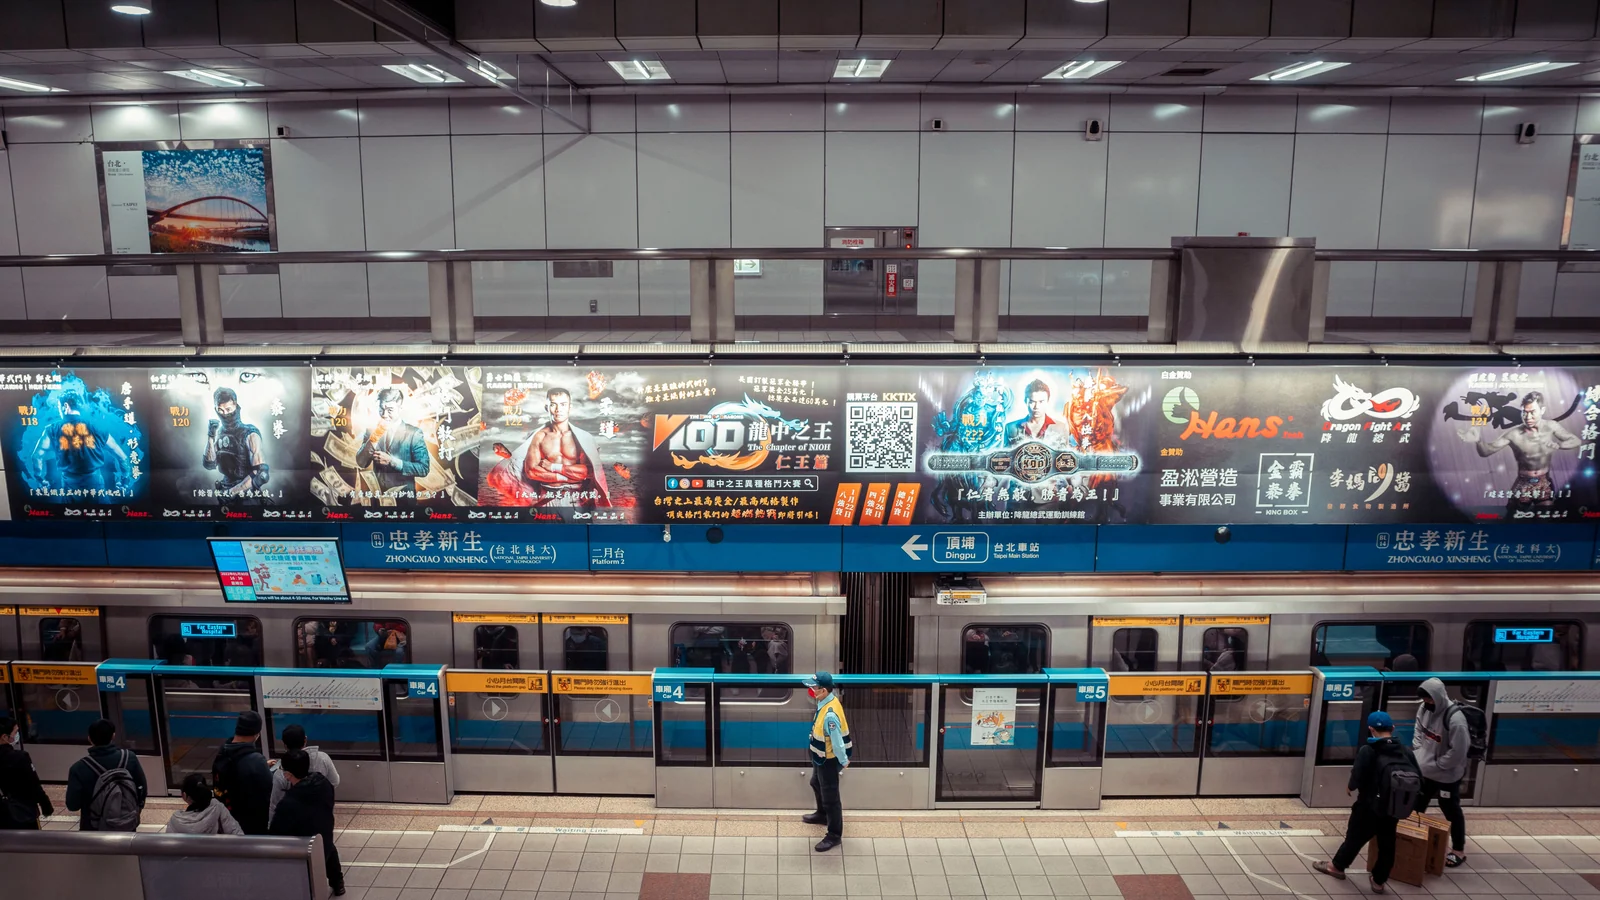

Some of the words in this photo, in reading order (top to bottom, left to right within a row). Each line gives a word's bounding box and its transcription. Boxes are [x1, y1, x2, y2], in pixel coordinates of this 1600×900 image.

[882, 393, 916, 401] KKTIX
[21, 417, 38, 426] 118
[172, 418, 190, 427] 120
[330, 418, 347, 427] 120
[505, 418, 523, 426] 122
[1180, 411, 1284, 441] Hans
[1322, 421, 1361, 432] Dragon
[1363, 421, 1392, 432] Fight
[1393, 421, 1412, 431] Art
[1471, 418, 1487, 426] 121
[748, 421, 833, 441] 龍中之王
[747, 443, 763, 451] The
[766, 443, 796, 452] Chapter
[798, 443, 808, 451] of
[775, 454, 829, 470] 仁王篇
[1160, 468, 1238, 487] 盈淞營造
[1159, 493, 1236, 507] 事業有限公司
[389, 530, 484, 551] 忠孝新生
[947, 536, 975, 550] 頂埔
[1393, 530, 1489, 551] 忠孝新生
[254, 544, 288, 555] 2022
[495, 544, 551, 555] 台北科大
[592, 547, 625, 559] 二月台
[994, 543, 1040, 552] 台北車站
[1500, 543, 1556, 554] 台北科大
[385, 555, 440, 563] ZHONGXIAO
[443, 555, 488, 564] XINSHENG
[946, 552, 976, 560] Dingpu
[1388, 555, 1443, 564] ZHONGXIAO
[1446, 555, 1491, 563] XINSHENG
[115, 676, 125, 689] 4
[426, 682, 437, 695] 4
[673, 685, 683, 699] 4
[1095, 686, 1105, 699] 5
[1342, 684, 1353, 697] 5
